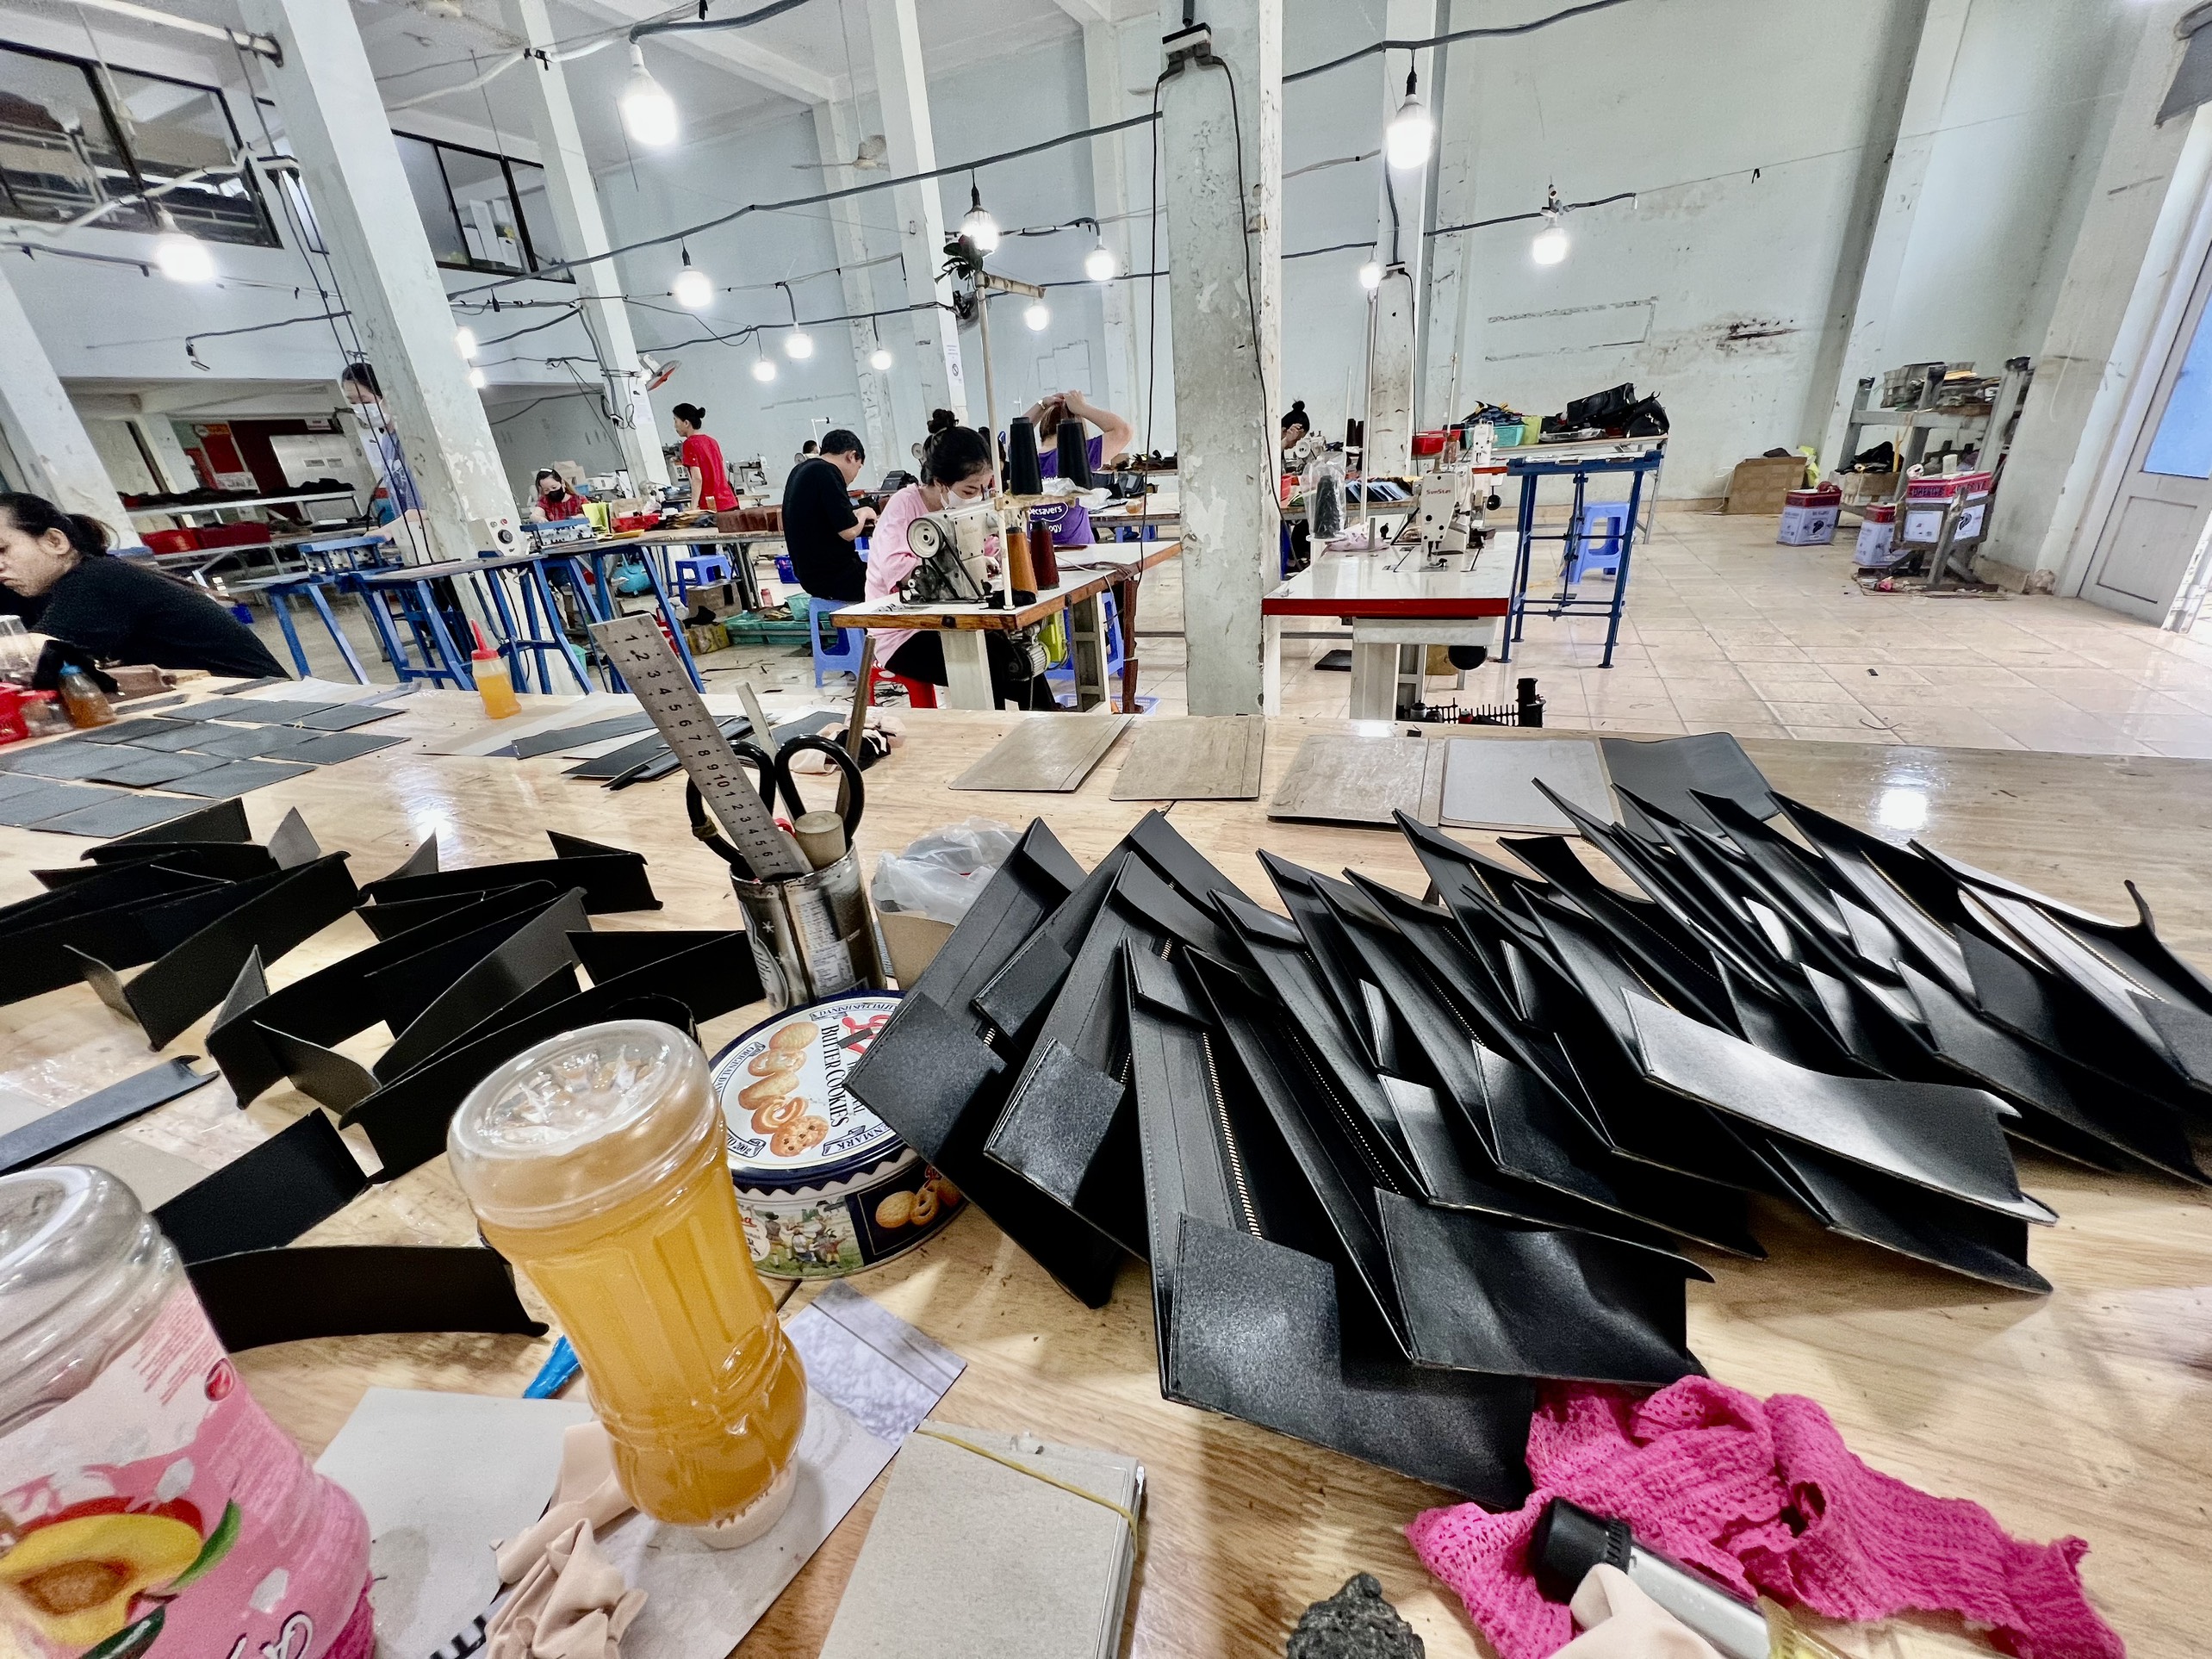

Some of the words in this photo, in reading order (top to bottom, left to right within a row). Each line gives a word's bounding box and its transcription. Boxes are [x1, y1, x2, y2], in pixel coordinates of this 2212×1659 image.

[636, 652, 650, 662] 2
[647, 669, 661, 679] 3
[713, 774, 730, 788] 10
[723, 1047, 755, 1075] ORIGINAL
[821, 1024, 841, 1071] BUTTER
[825, 1069, 849, 1128] COOKIES
[837, 1123, 889, 1151] ENMARK
